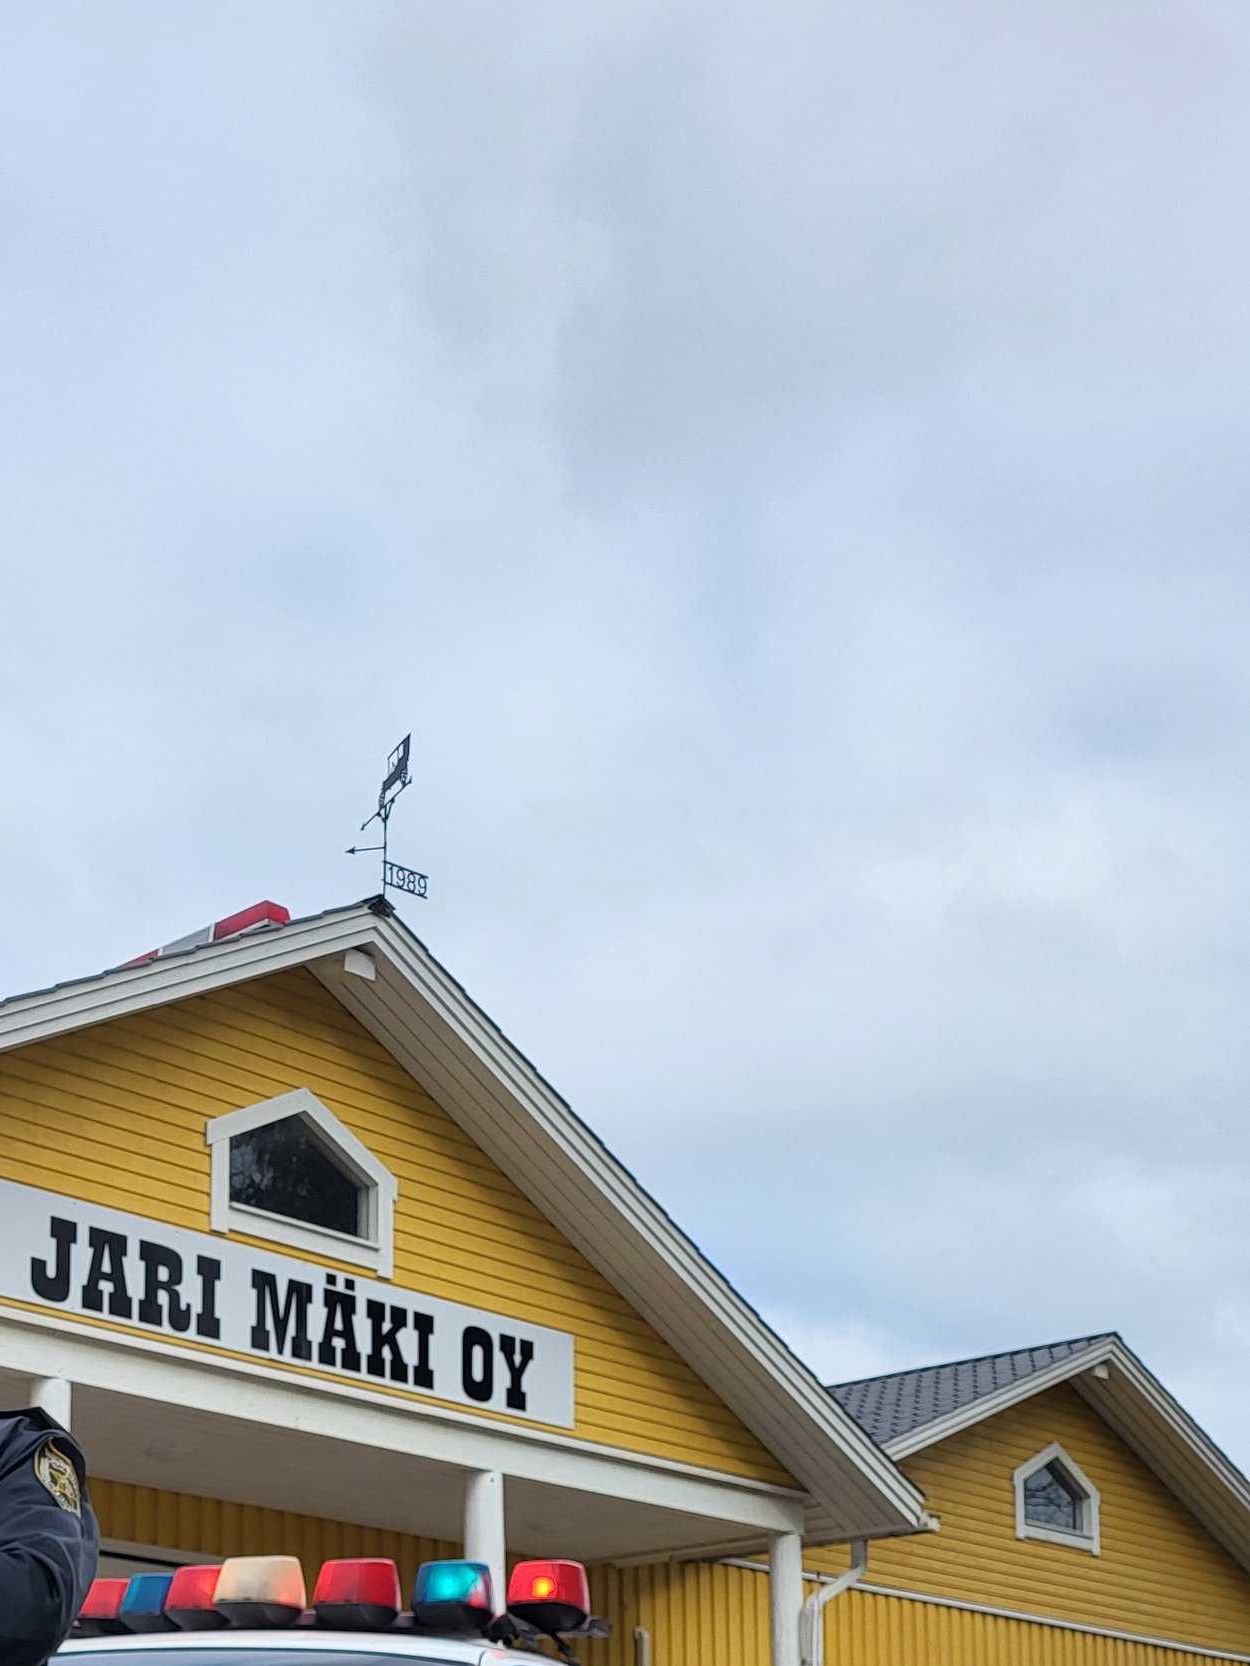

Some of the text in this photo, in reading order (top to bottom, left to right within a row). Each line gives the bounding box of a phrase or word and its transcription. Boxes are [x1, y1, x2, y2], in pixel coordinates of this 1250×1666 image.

[389, 864, 427, 896] 1989
[30, 1216, 534, 1411] JARI MÄKI OY
